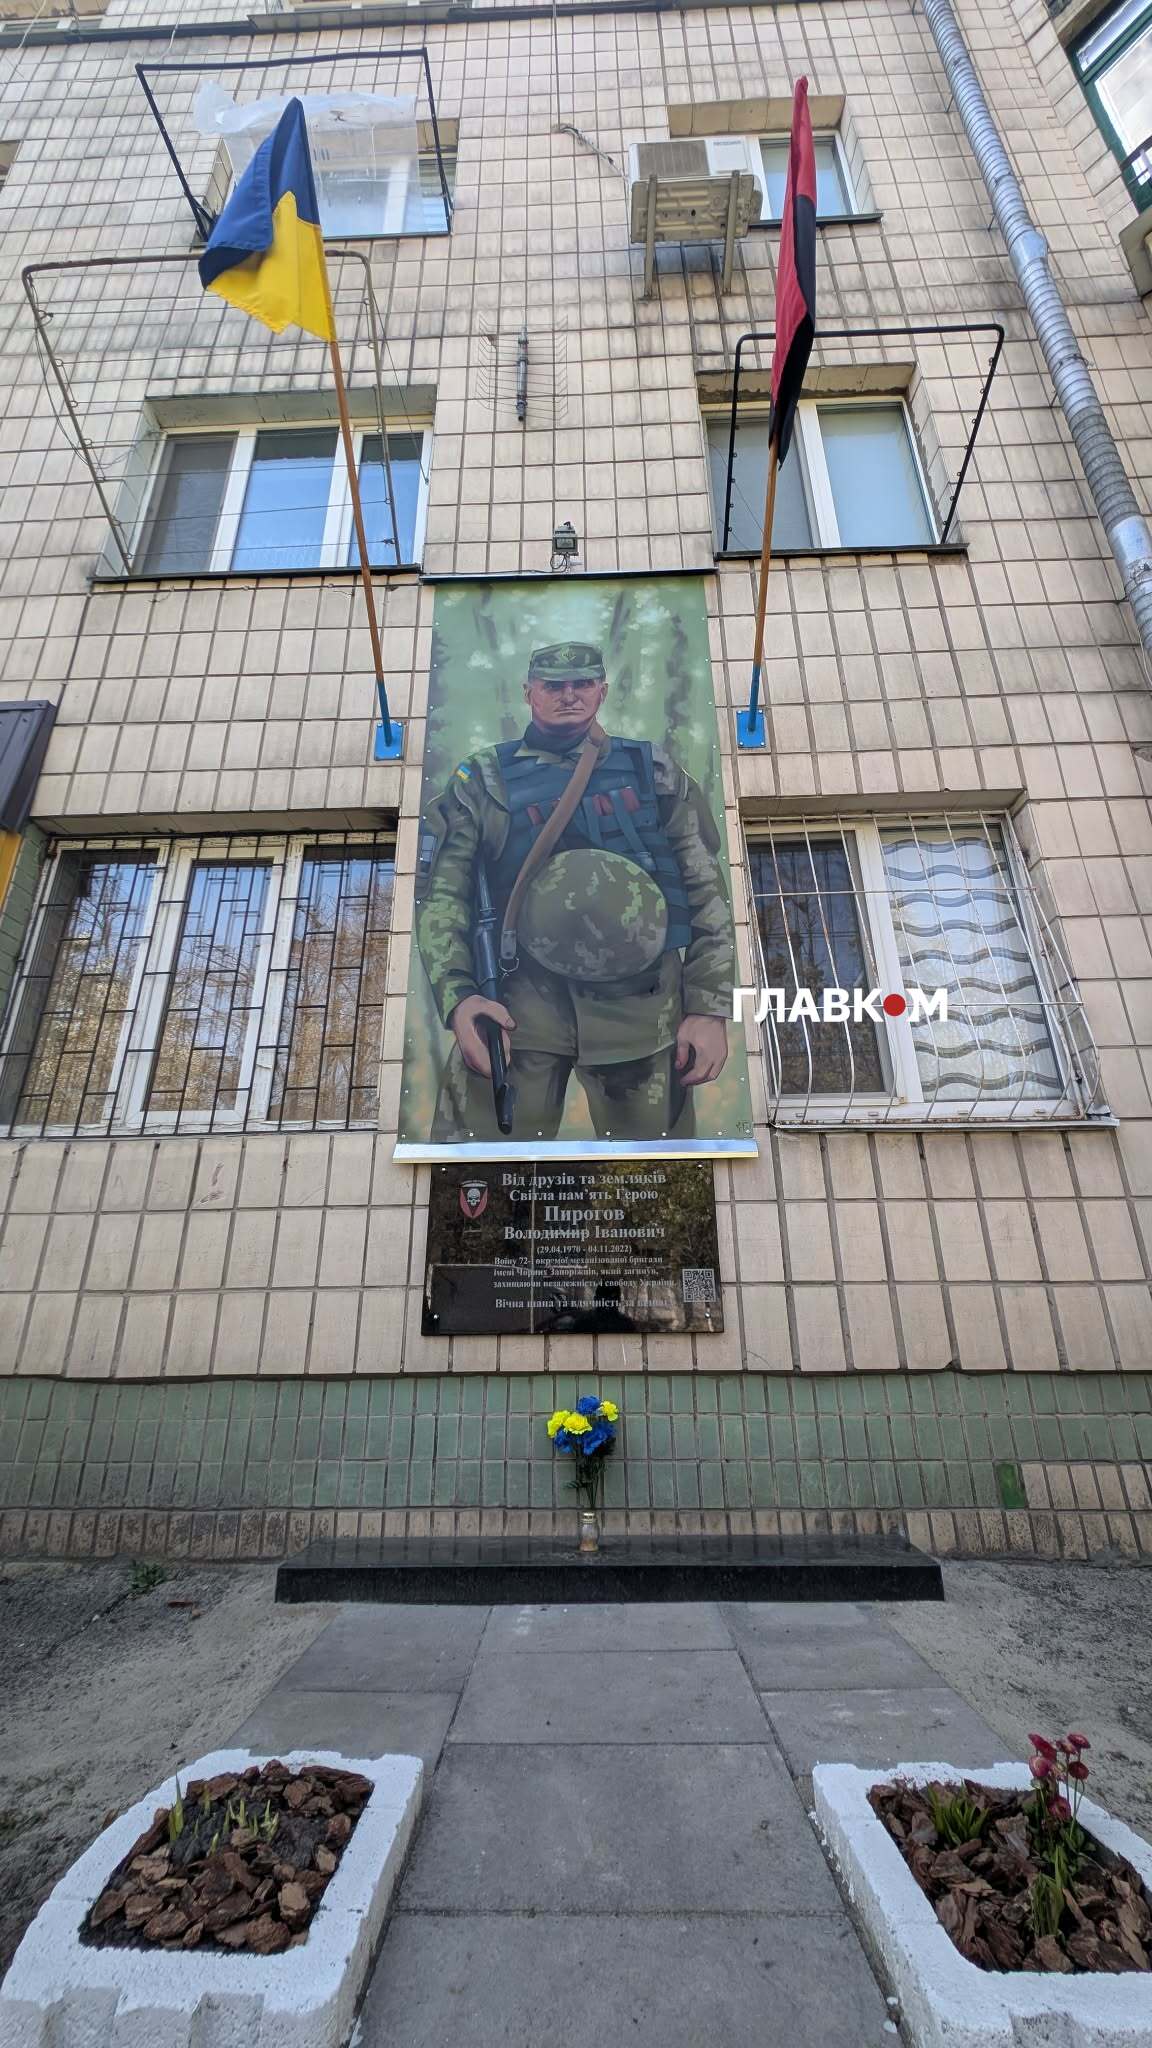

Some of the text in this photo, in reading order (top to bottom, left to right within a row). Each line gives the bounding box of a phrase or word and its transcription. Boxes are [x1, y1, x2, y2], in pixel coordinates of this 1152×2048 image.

[502, 1172, 666, 1188] Від друзів та земляків
[510, 1189, 555, 1201] Світла
[616, 1189, 658, 1203] Герою
[544, 1205, 625, 1225] Пирогов
[504, 1226, 665, 1241] Володимир Іванович
[495, 1257, 516, 1266] Воїну
[536, 1257, 568, 1267] окремої
[569, 1256, 627, 1265] механізованої
[629, 1256, 663, 1265] бригади
[495, 1298, 524, 1308] Вічна
